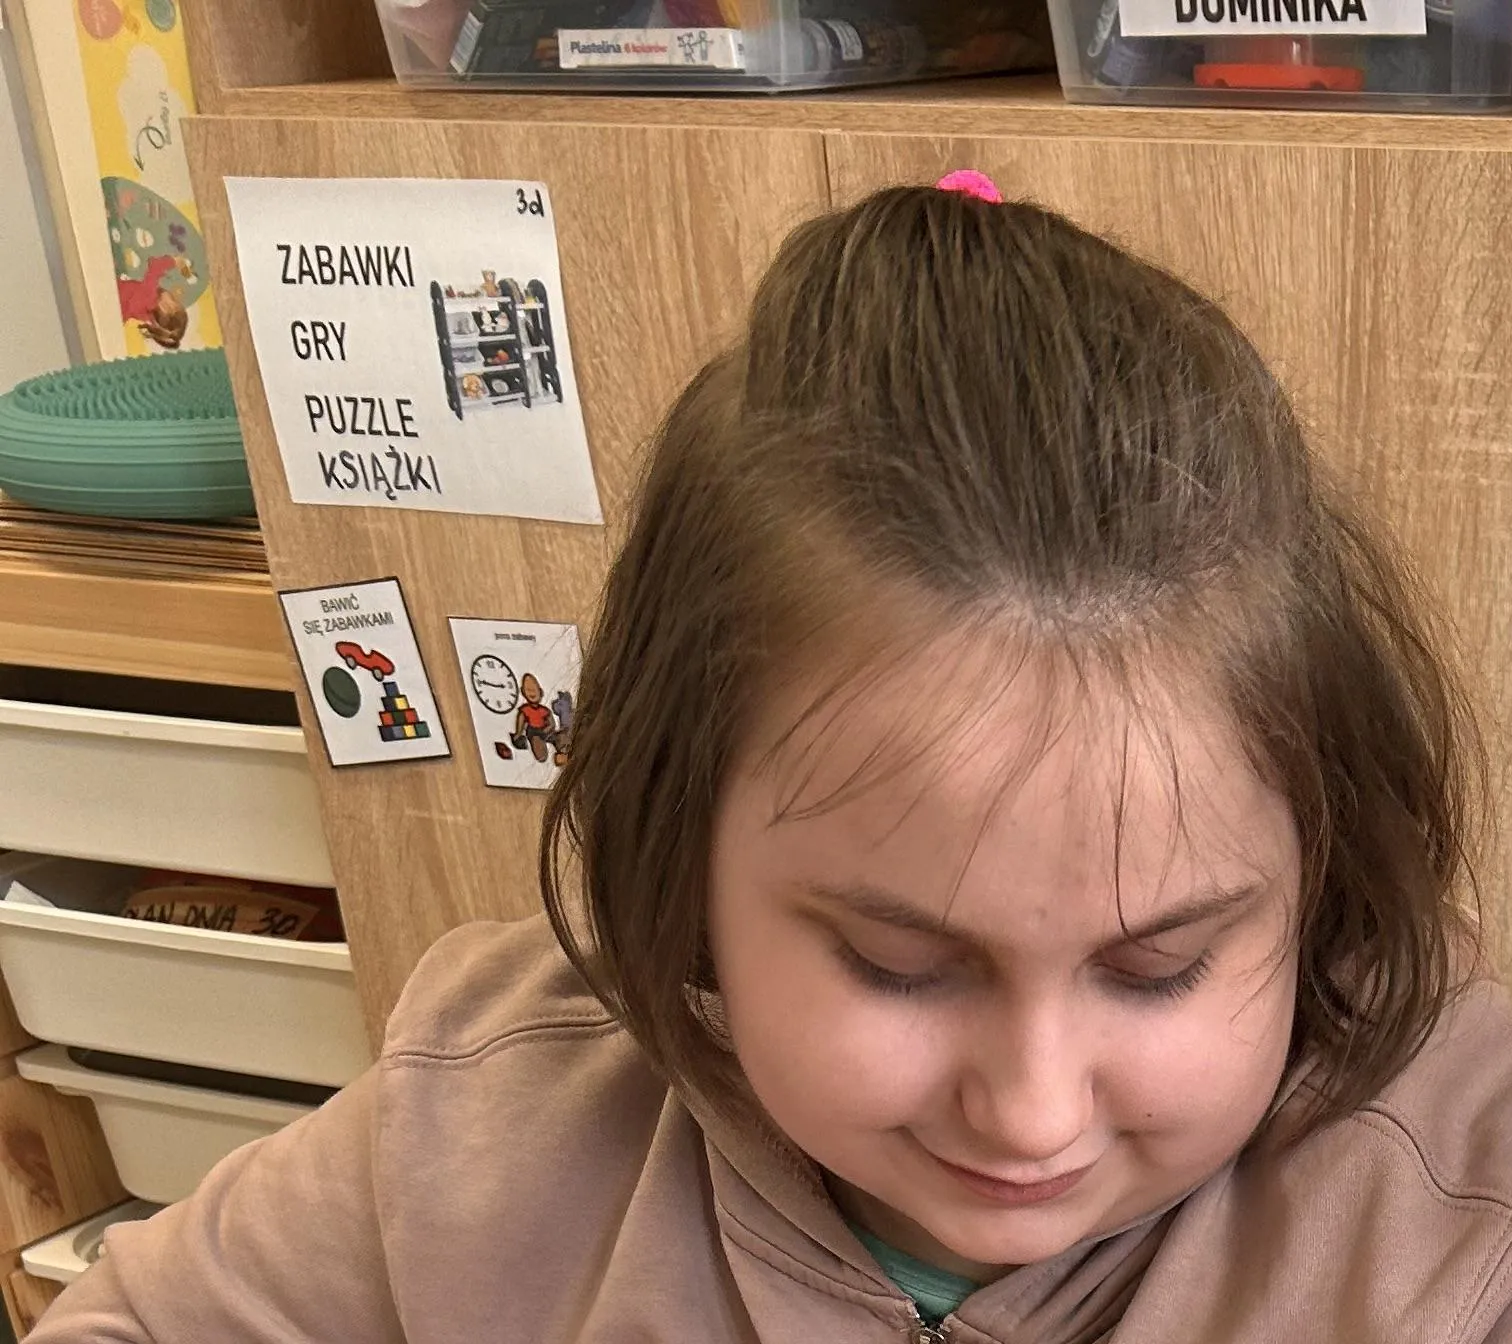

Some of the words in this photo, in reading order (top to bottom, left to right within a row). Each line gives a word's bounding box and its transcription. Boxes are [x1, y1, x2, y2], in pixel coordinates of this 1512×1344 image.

[570, 41, 621, 54] Plastelina
[515, 187, 545, 218] 3d
[276, 243, 416, 288] ZABAWKI
[290, 319, 347, 362] GRY
[304, 393, 419, 438] PUZZLE
[318, 445, 442, 500] KSIĄŻKI
[320, 593, 361, 613] BAWIĆ
[303, 620, 325, 637] SIĘ
[325, 611, 395, 634] ZABAWKAMI
